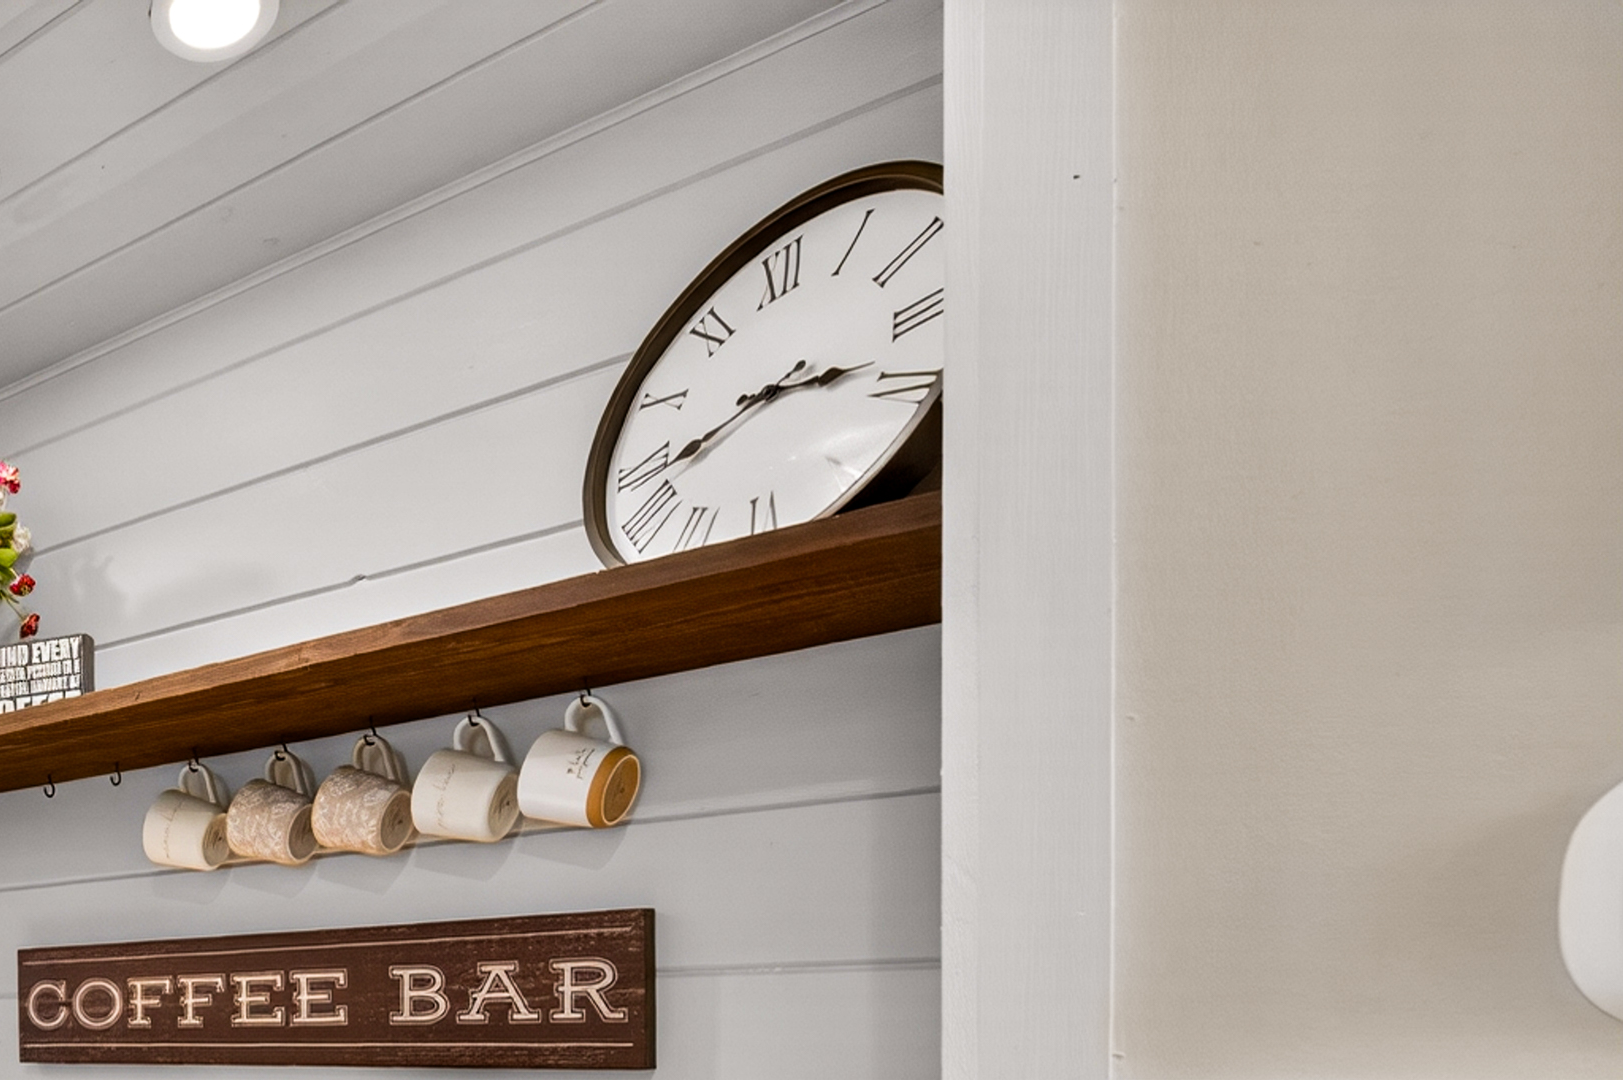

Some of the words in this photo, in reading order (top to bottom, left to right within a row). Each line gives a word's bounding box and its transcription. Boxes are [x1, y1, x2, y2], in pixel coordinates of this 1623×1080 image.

[756, 234, 804, 312] XII
[689, 306, 736, 358] XI
[638, 388, 689, 411] X
[32, 635, 82, 664] EVERY
[27, 968, 349, 1030] COFFEE
[388, 956, 629, 1026] BAR
